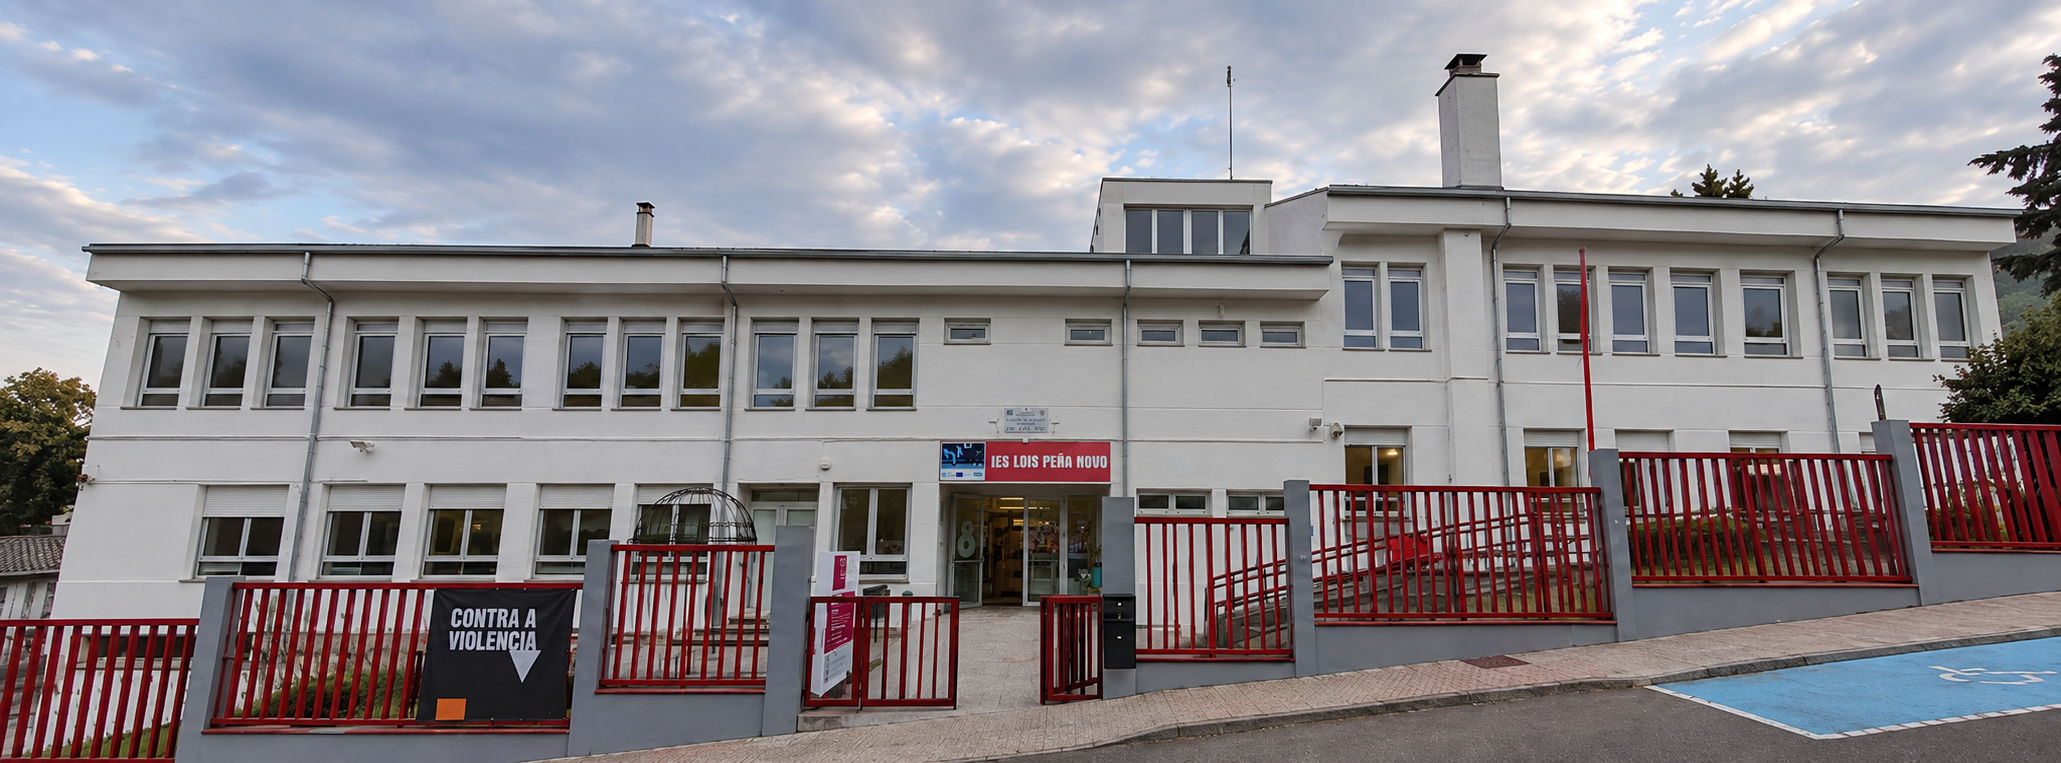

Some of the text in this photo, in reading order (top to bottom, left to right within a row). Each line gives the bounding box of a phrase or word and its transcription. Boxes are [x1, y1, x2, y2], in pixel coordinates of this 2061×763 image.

[991, 453, 1108, 469] IES LOIS PEÑA NOVO
[450, 608, 536, 628] CONTRA A
[449, 630, 537, 650] VIOLENCIA
